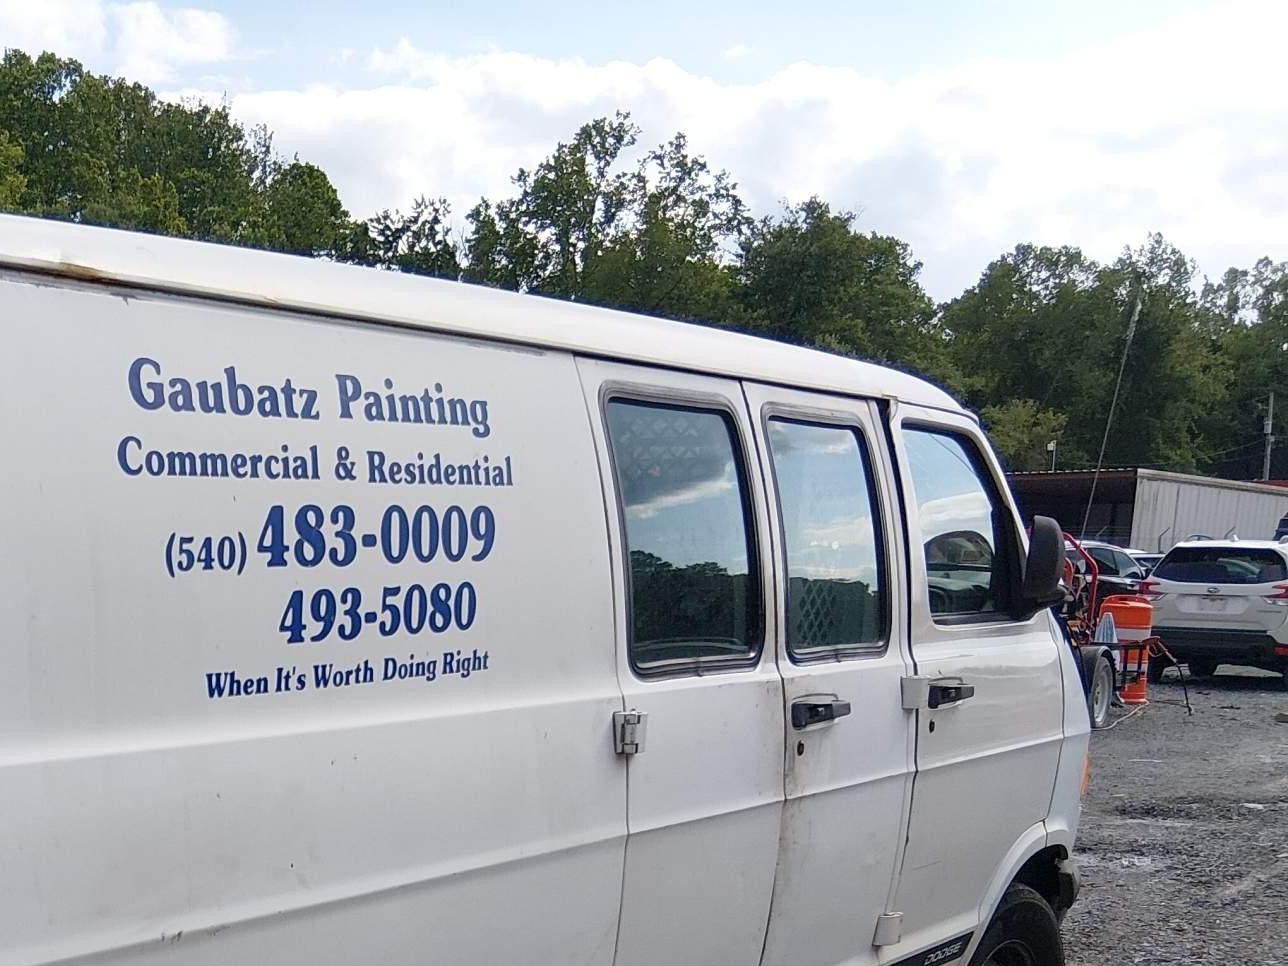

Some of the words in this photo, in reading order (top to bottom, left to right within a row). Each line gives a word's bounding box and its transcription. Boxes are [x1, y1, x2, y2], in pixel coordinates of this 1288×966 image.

[128, 357, 320, 420] Gaubatz
[336, 374, 491, 438] Painting
[117, 436, 320, 480] Commercial
[335, 447, 357, 481] &
[367, 450, 513, 486] Residential
[166, 532, 248, 578] (540)
[257, 504, 496, 567] 483-0009
[279, 581, 477, 644] 493-5080
[206, 672, 269, 699] When
[275, 667, 307, 692] It's
[313, 663, 374, 689] Worth
[382, 654, 437, 681] Doing
[442, 649, 489, 675] Right
[923, 941, 963, 966] DODGE
